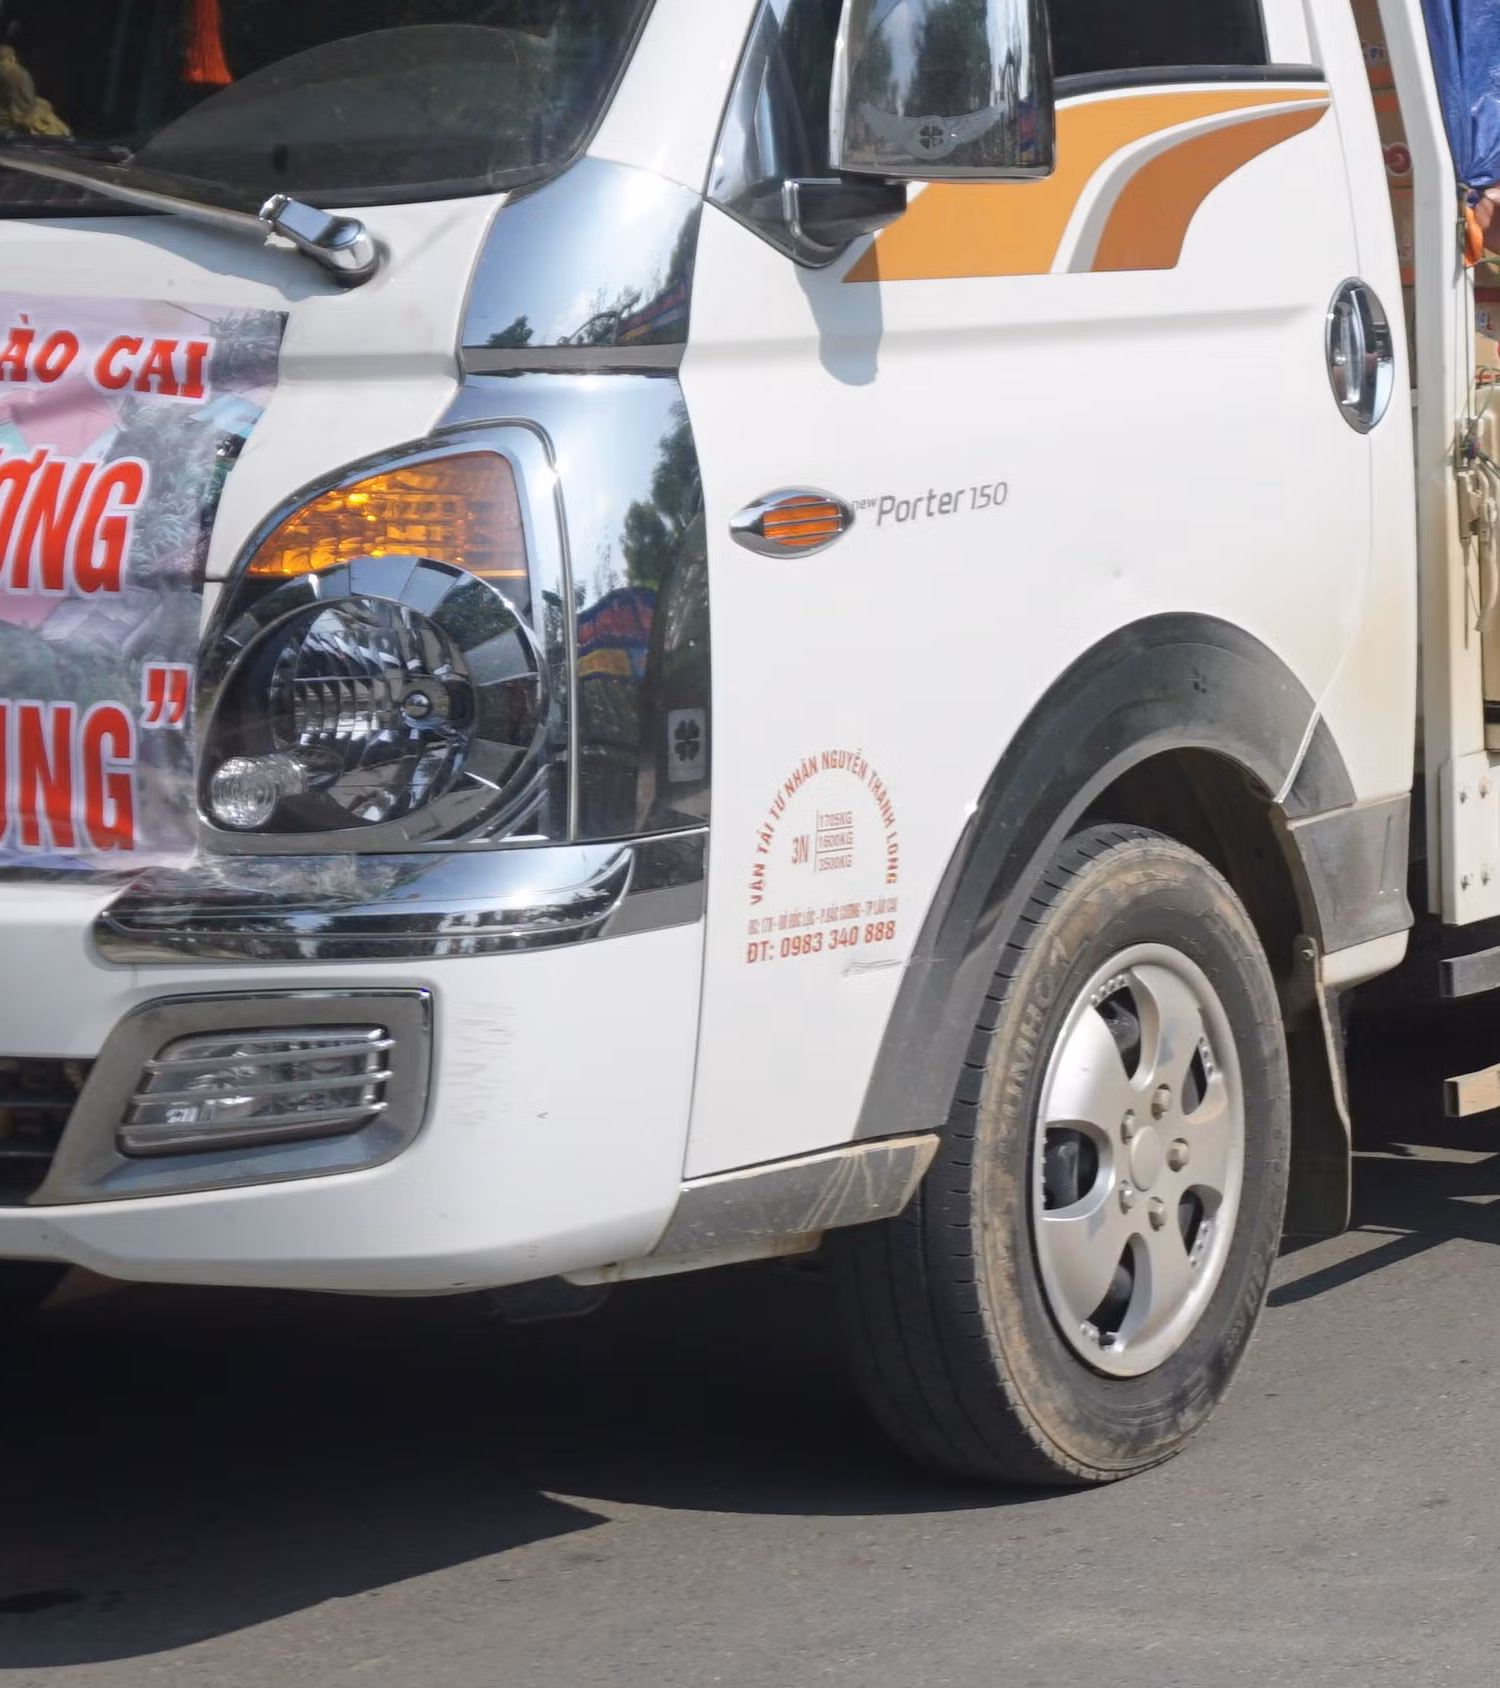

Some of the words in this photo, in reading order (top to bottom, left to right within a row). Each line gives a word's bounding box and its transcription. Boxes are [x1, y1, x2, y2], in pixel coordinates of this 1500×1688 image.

[96, 336, 213, 399] CAI
[852, 496, 877, 511] new
[876, 488, 966, 527] Porter
[969, 481, 1009, 511] 150
[885, 831, 900, 885] LONG
[746, 940, 775, 964] ĐT:
[780, 931, 823, 959] 0983
[828, 925, 860, 950] 340
[864, 919, 896, 944] 888
